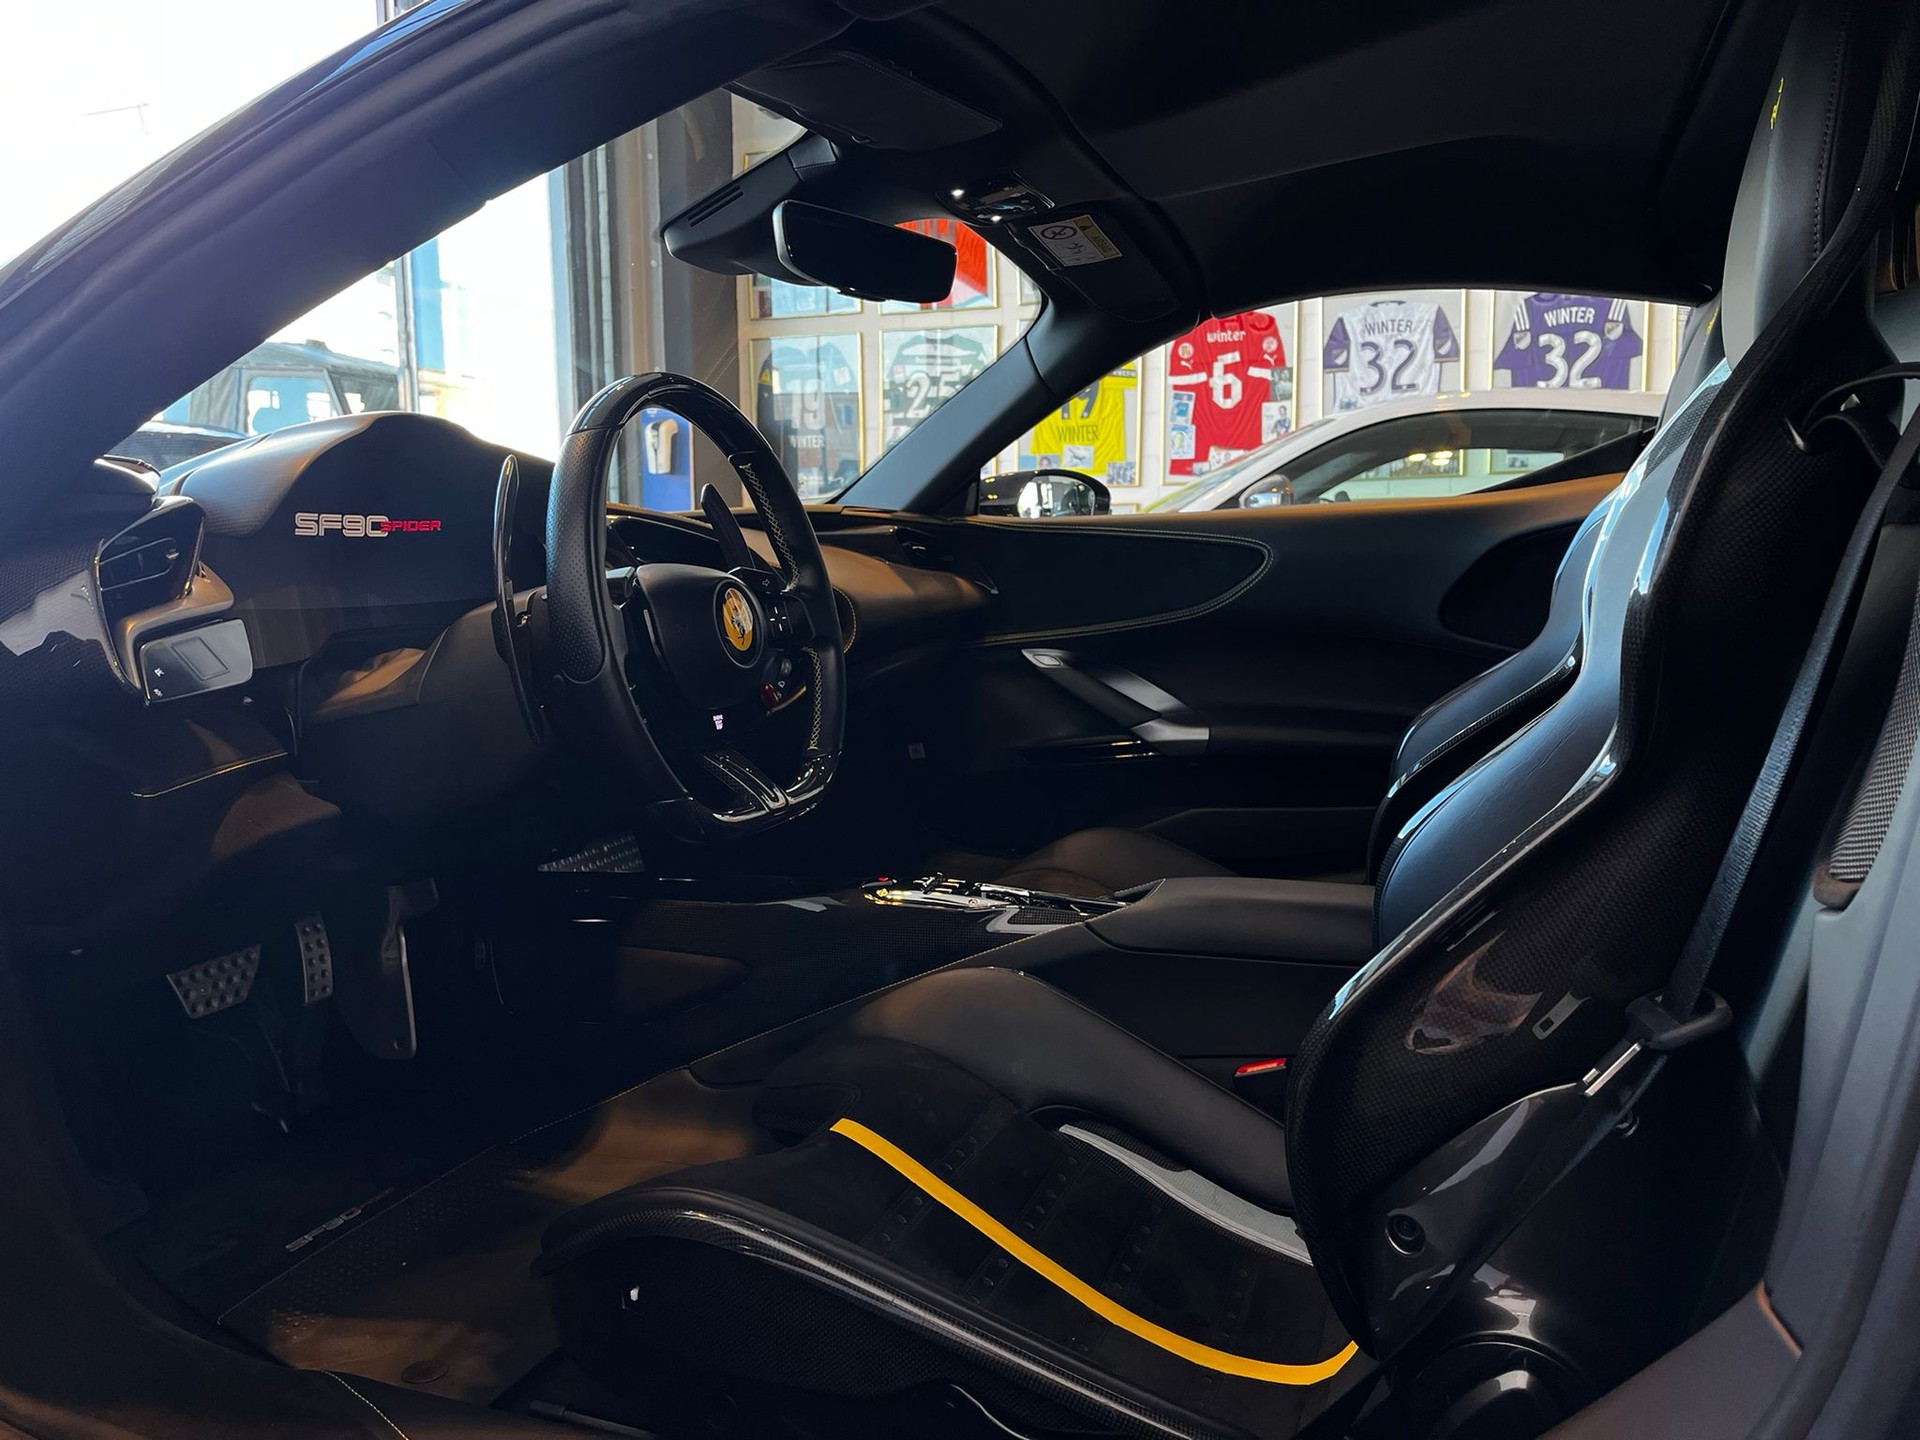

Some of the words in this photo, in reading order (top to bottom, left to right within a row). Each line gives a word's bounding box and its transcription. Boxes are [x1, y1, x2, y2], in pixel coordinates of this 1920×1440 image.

[1365, 319, 1413, 335] WINTER
[1544, 307, 1595, 327] WINTER
[1207, 330, 1247, 343] winter
[1360, 339, 1419, 395] 32
[1537, 331, 1602, 388] 32
[1209, 351, 1243, 410] 6
[787, 378, 825, 430] 19
[789, 434, 825, 448] WINTER
[1057, 425, 1100, 442] WINTER
[295, 512, 389, 537] SF90
[380, 520, 442, 532] SPIDER
